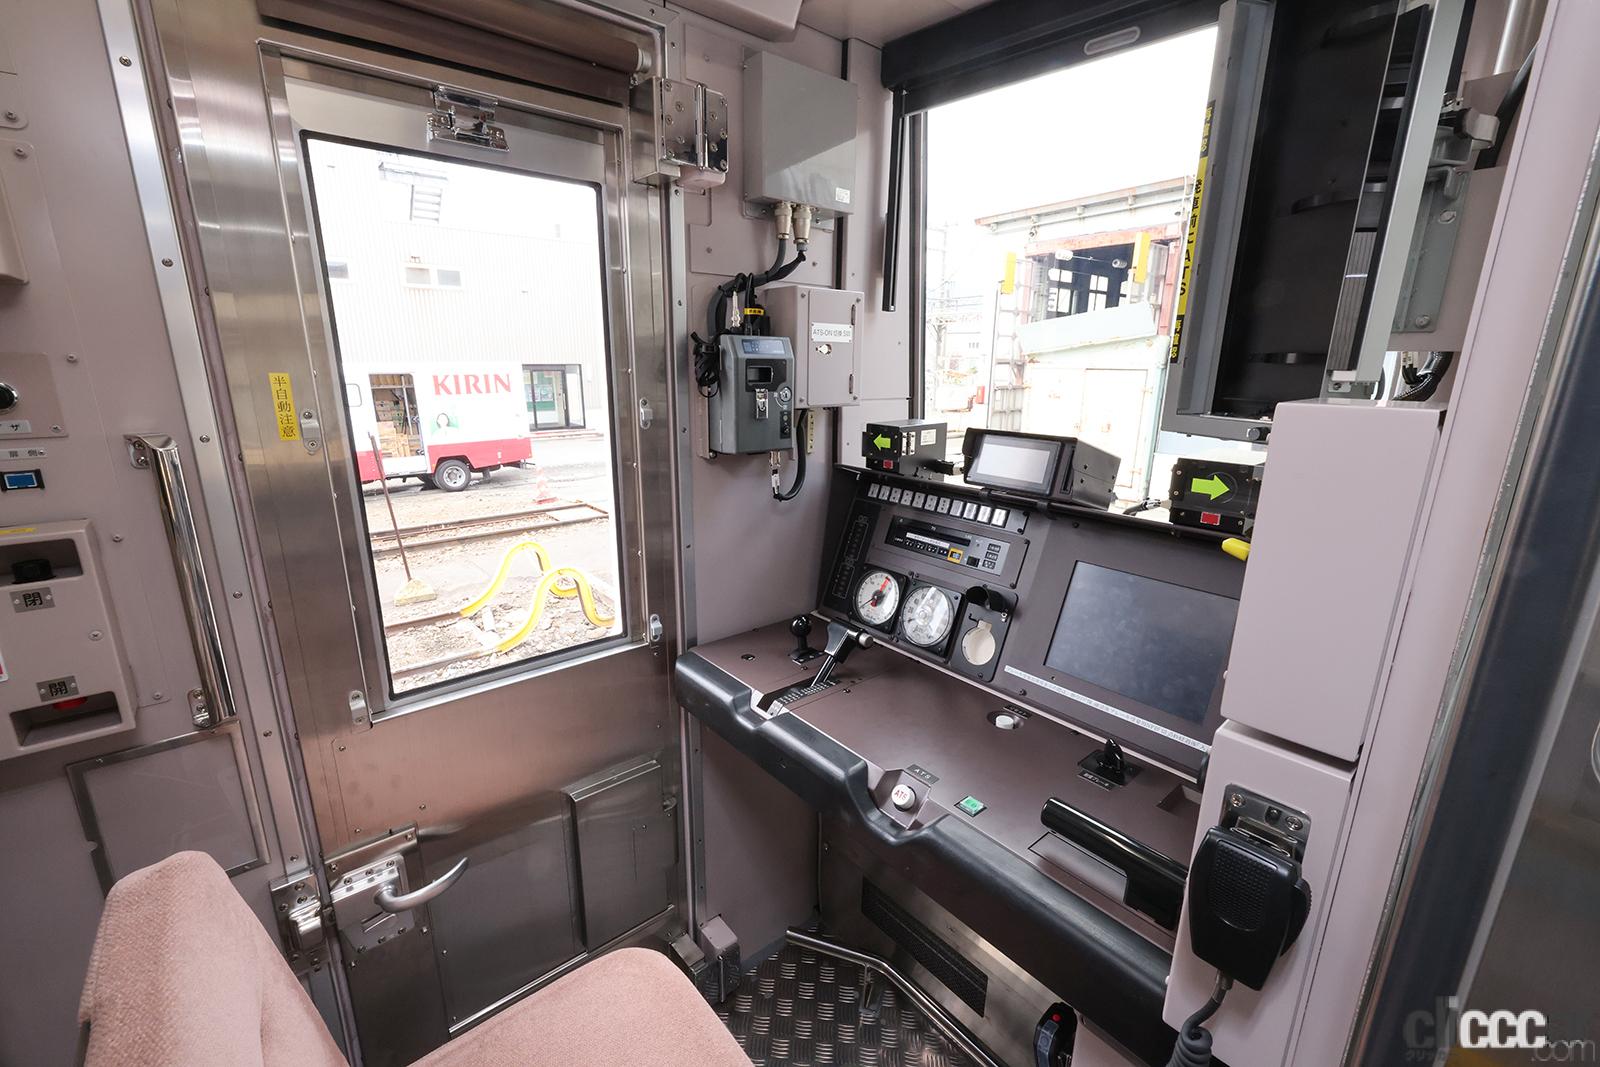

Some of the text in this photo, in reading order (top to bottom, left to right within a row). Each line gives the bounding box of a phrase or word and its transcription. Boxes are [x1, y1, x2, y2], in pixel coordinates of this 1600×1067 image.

[432, 373, 511, 396] KIRIN
[273, 376, 295, 438] 半自動注意
[22, 591, 43, 608] 閉
[48, 681, 69, 697] 開
[913, 768, 931, 779] ATS
[894, 789, 909, 801] ATS
